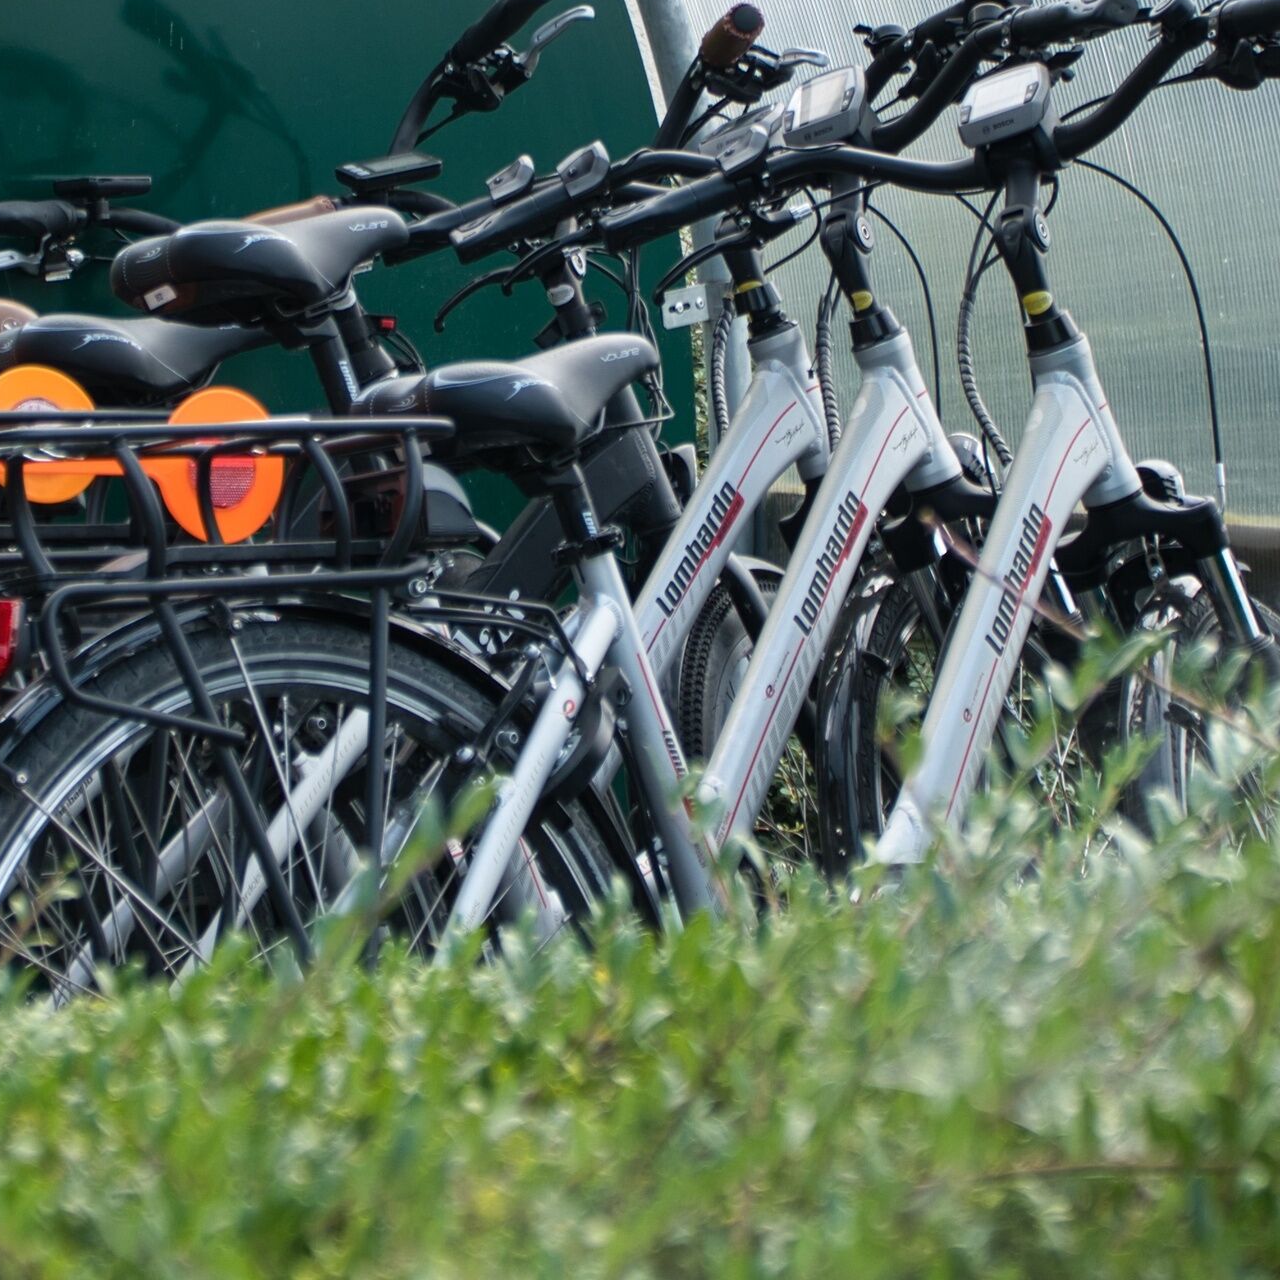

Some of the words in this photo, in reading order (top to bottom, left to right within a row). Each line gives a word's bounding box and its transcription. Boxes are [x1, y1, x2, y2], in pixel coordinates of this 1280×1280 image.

[655, 480, 738, 619] Lombardo
[793, 489, 861, 637] Lombardo
[984, 502, 1045, 658] Lombardo
